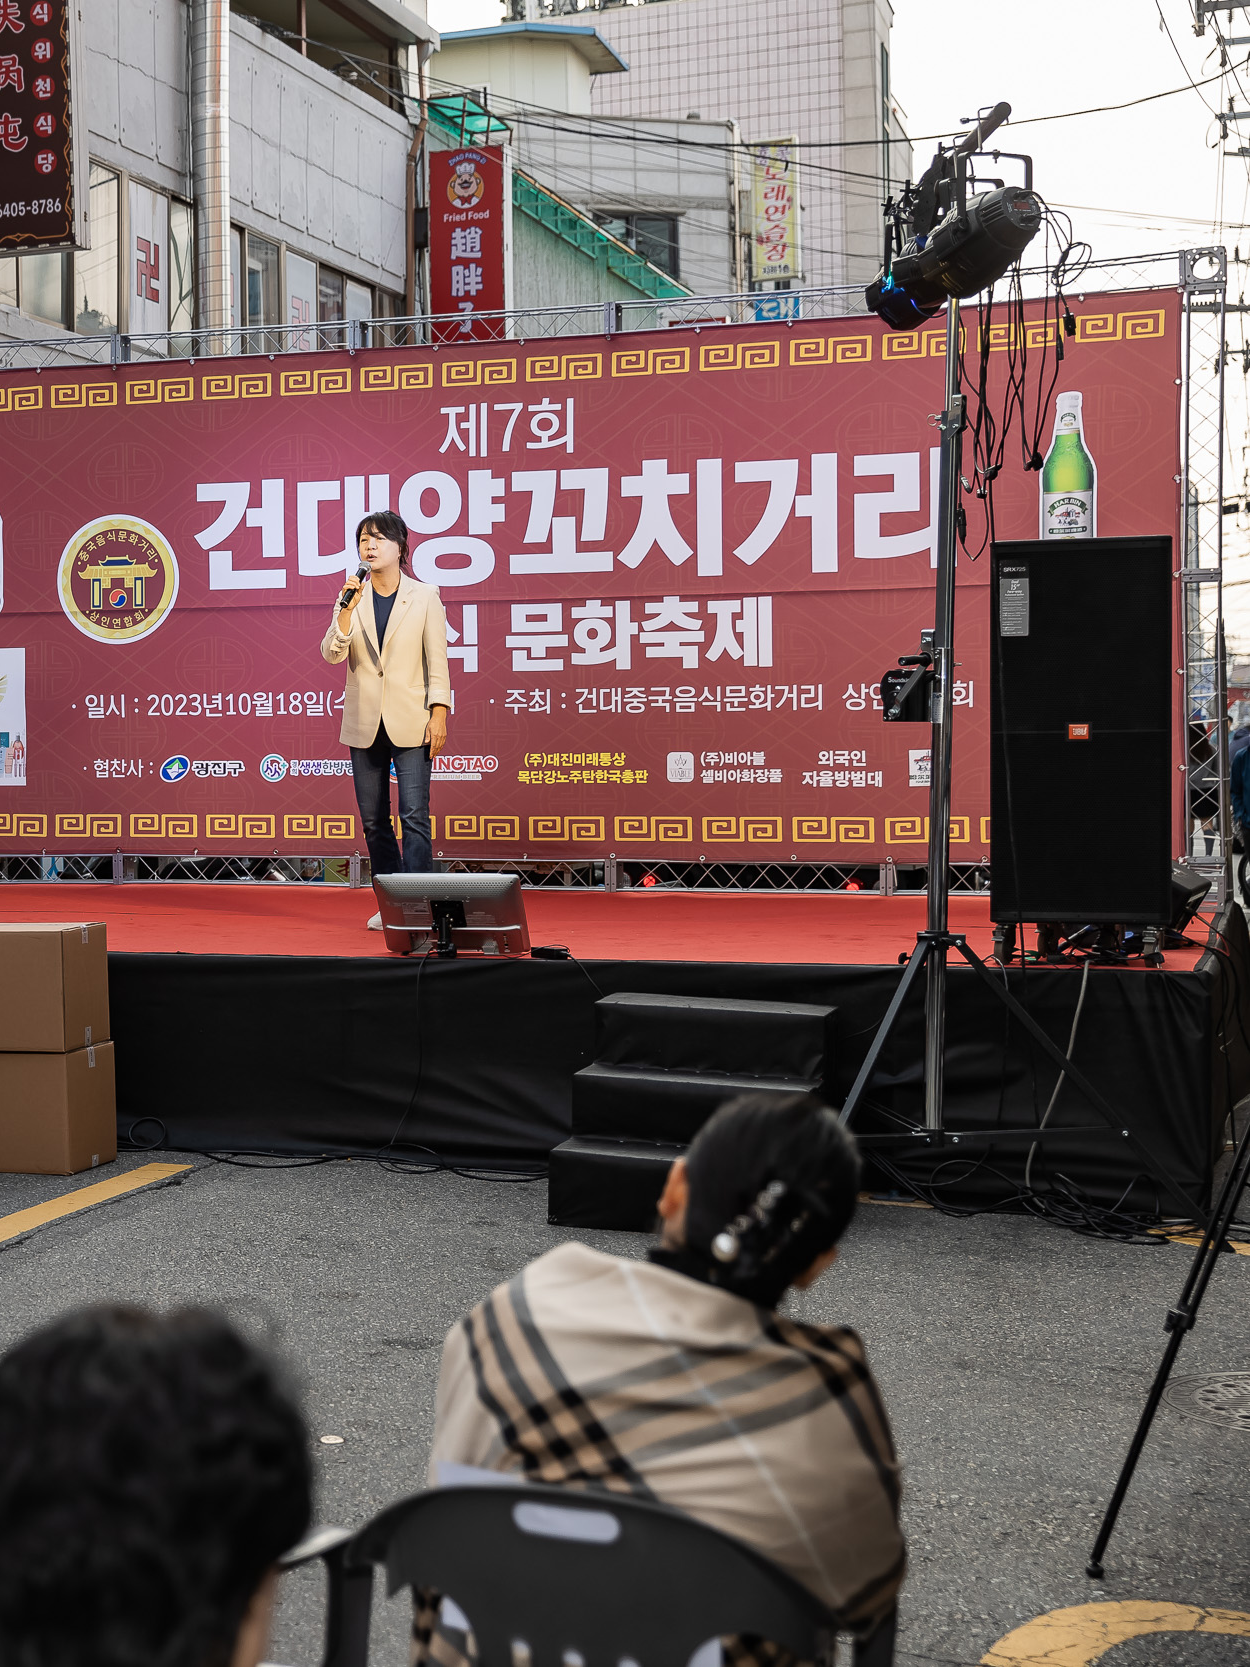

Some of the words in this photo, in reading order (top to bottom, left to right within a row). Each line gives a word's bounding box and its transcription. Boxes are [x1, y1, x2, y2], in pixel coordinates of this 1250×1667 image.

[32, 0, 55, 173] 식위천식당
[443, 212, 466, 222] Fried
[468, 209, 489, 220] Food
[451, 226, 483, 341] 趙胖子
[438, 398, 575, 458] 제7회
[1053, 497, 1082, 508] HARBIN
[194, 446, 956, 591] 건대양꼬치거리
[79, 531, 158, 563] 중국음식문화거리
[90, 611, 146, 629] 상인연합회
[506, 596, 773, 672] 문화축제
[85, 694, 125, 719] 일시
[504, 688, 552, 714] 주최
[575, 684, 824, 714] 건대중국음식문화거리
[842, 680, 974, 711] 상인회
[93, 758, 144, 778] 협찬사
[191, 759, 246, 778] 광진구
[432, 756, 497, 772] INGTAO
[524, 752, 626, 768] (주)대진미래통상
[700, 751, 766, 767] (주)비아블
[817, 750, 867, 767] 외국인
[517, 768, 649, 785] 목단강노주탄한국총판
[801, 770, 883, 788] 자율방범대
